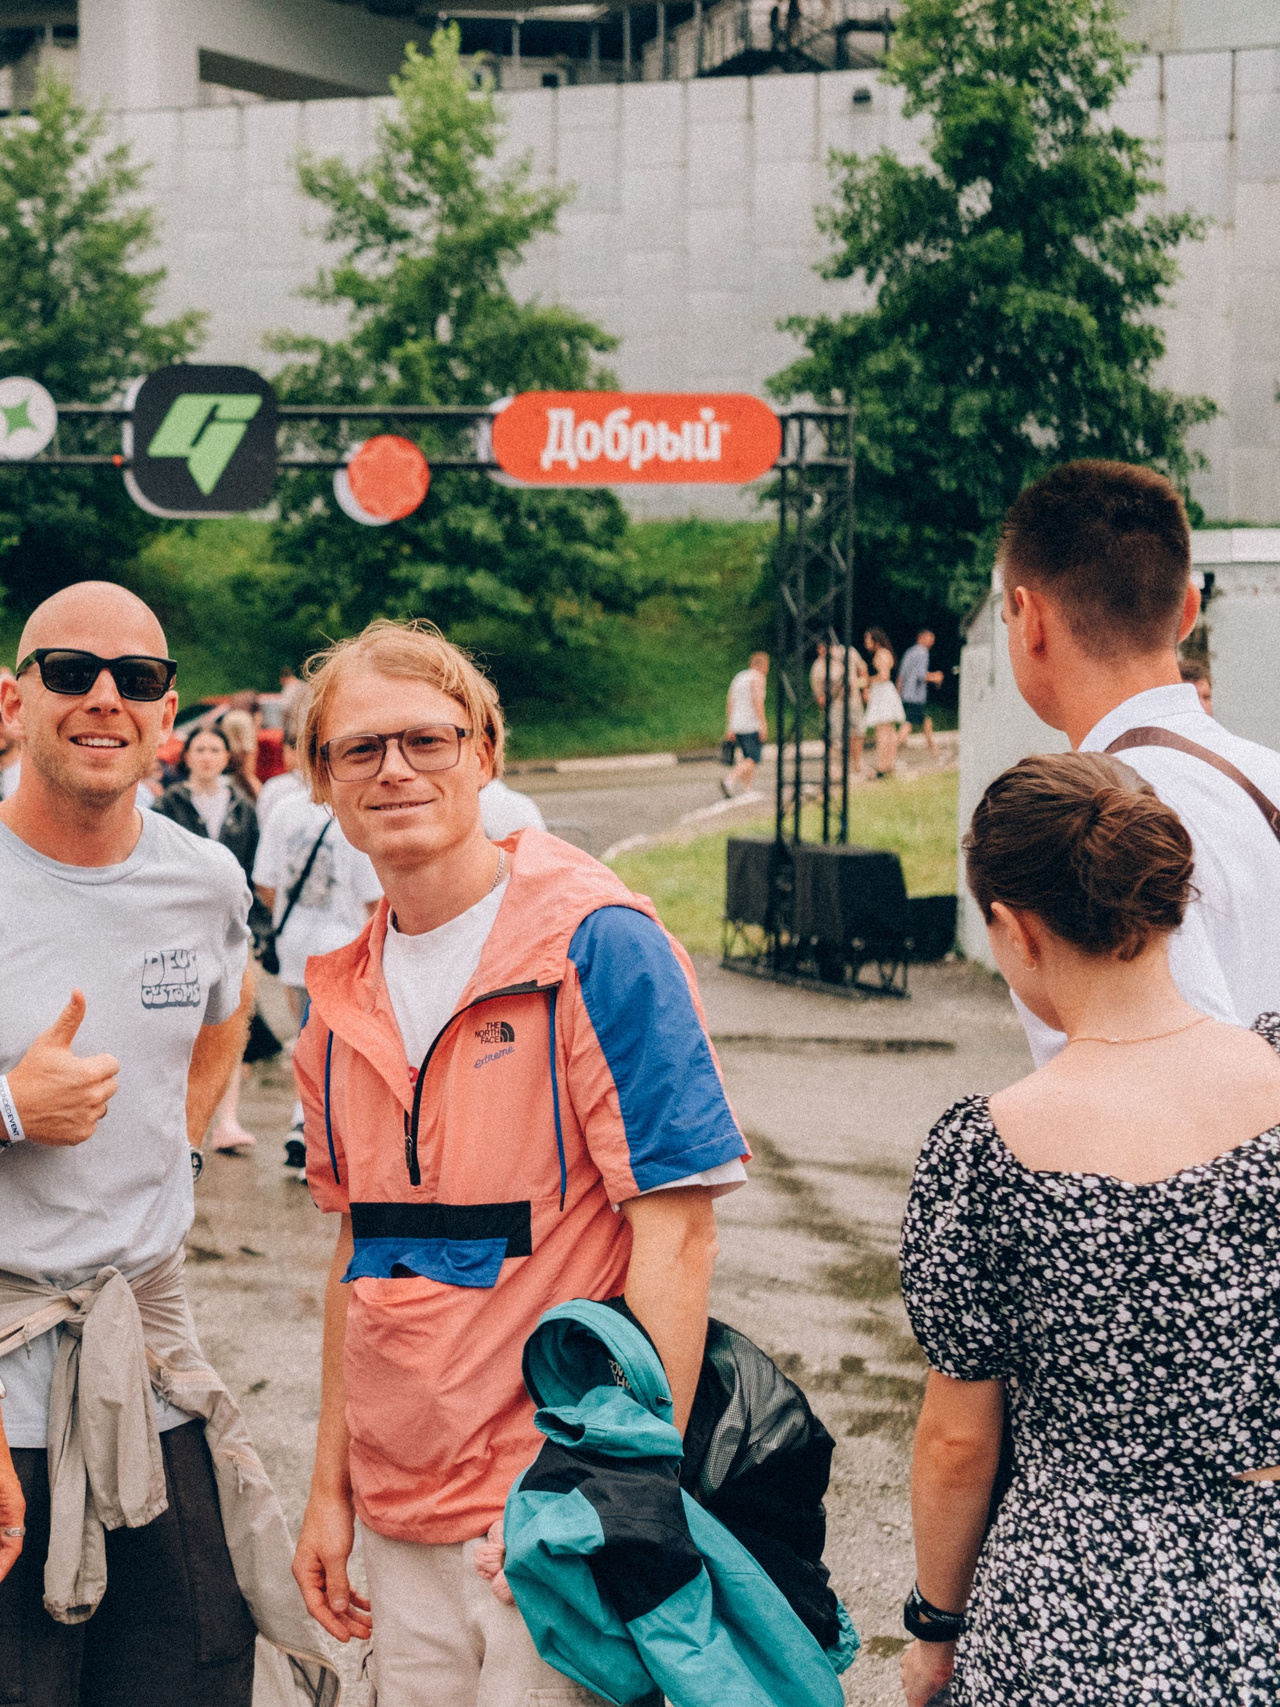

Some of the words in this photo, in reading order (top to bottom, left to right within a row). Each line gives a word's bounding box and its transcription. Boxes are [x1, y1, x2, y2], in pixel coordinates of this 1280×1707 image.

[540, 407, 721, 471] Добрый
[142, 948, 198, 987] DEUS
[141, 984, 200, 1009] CUSTOMS
[475, 1029, 500, 1038] NORTH
[486, 1021, 500, 1029] THE
[480, 1036, 500, 1044] FACE
[473, 1046, 515, 1068] extreme
